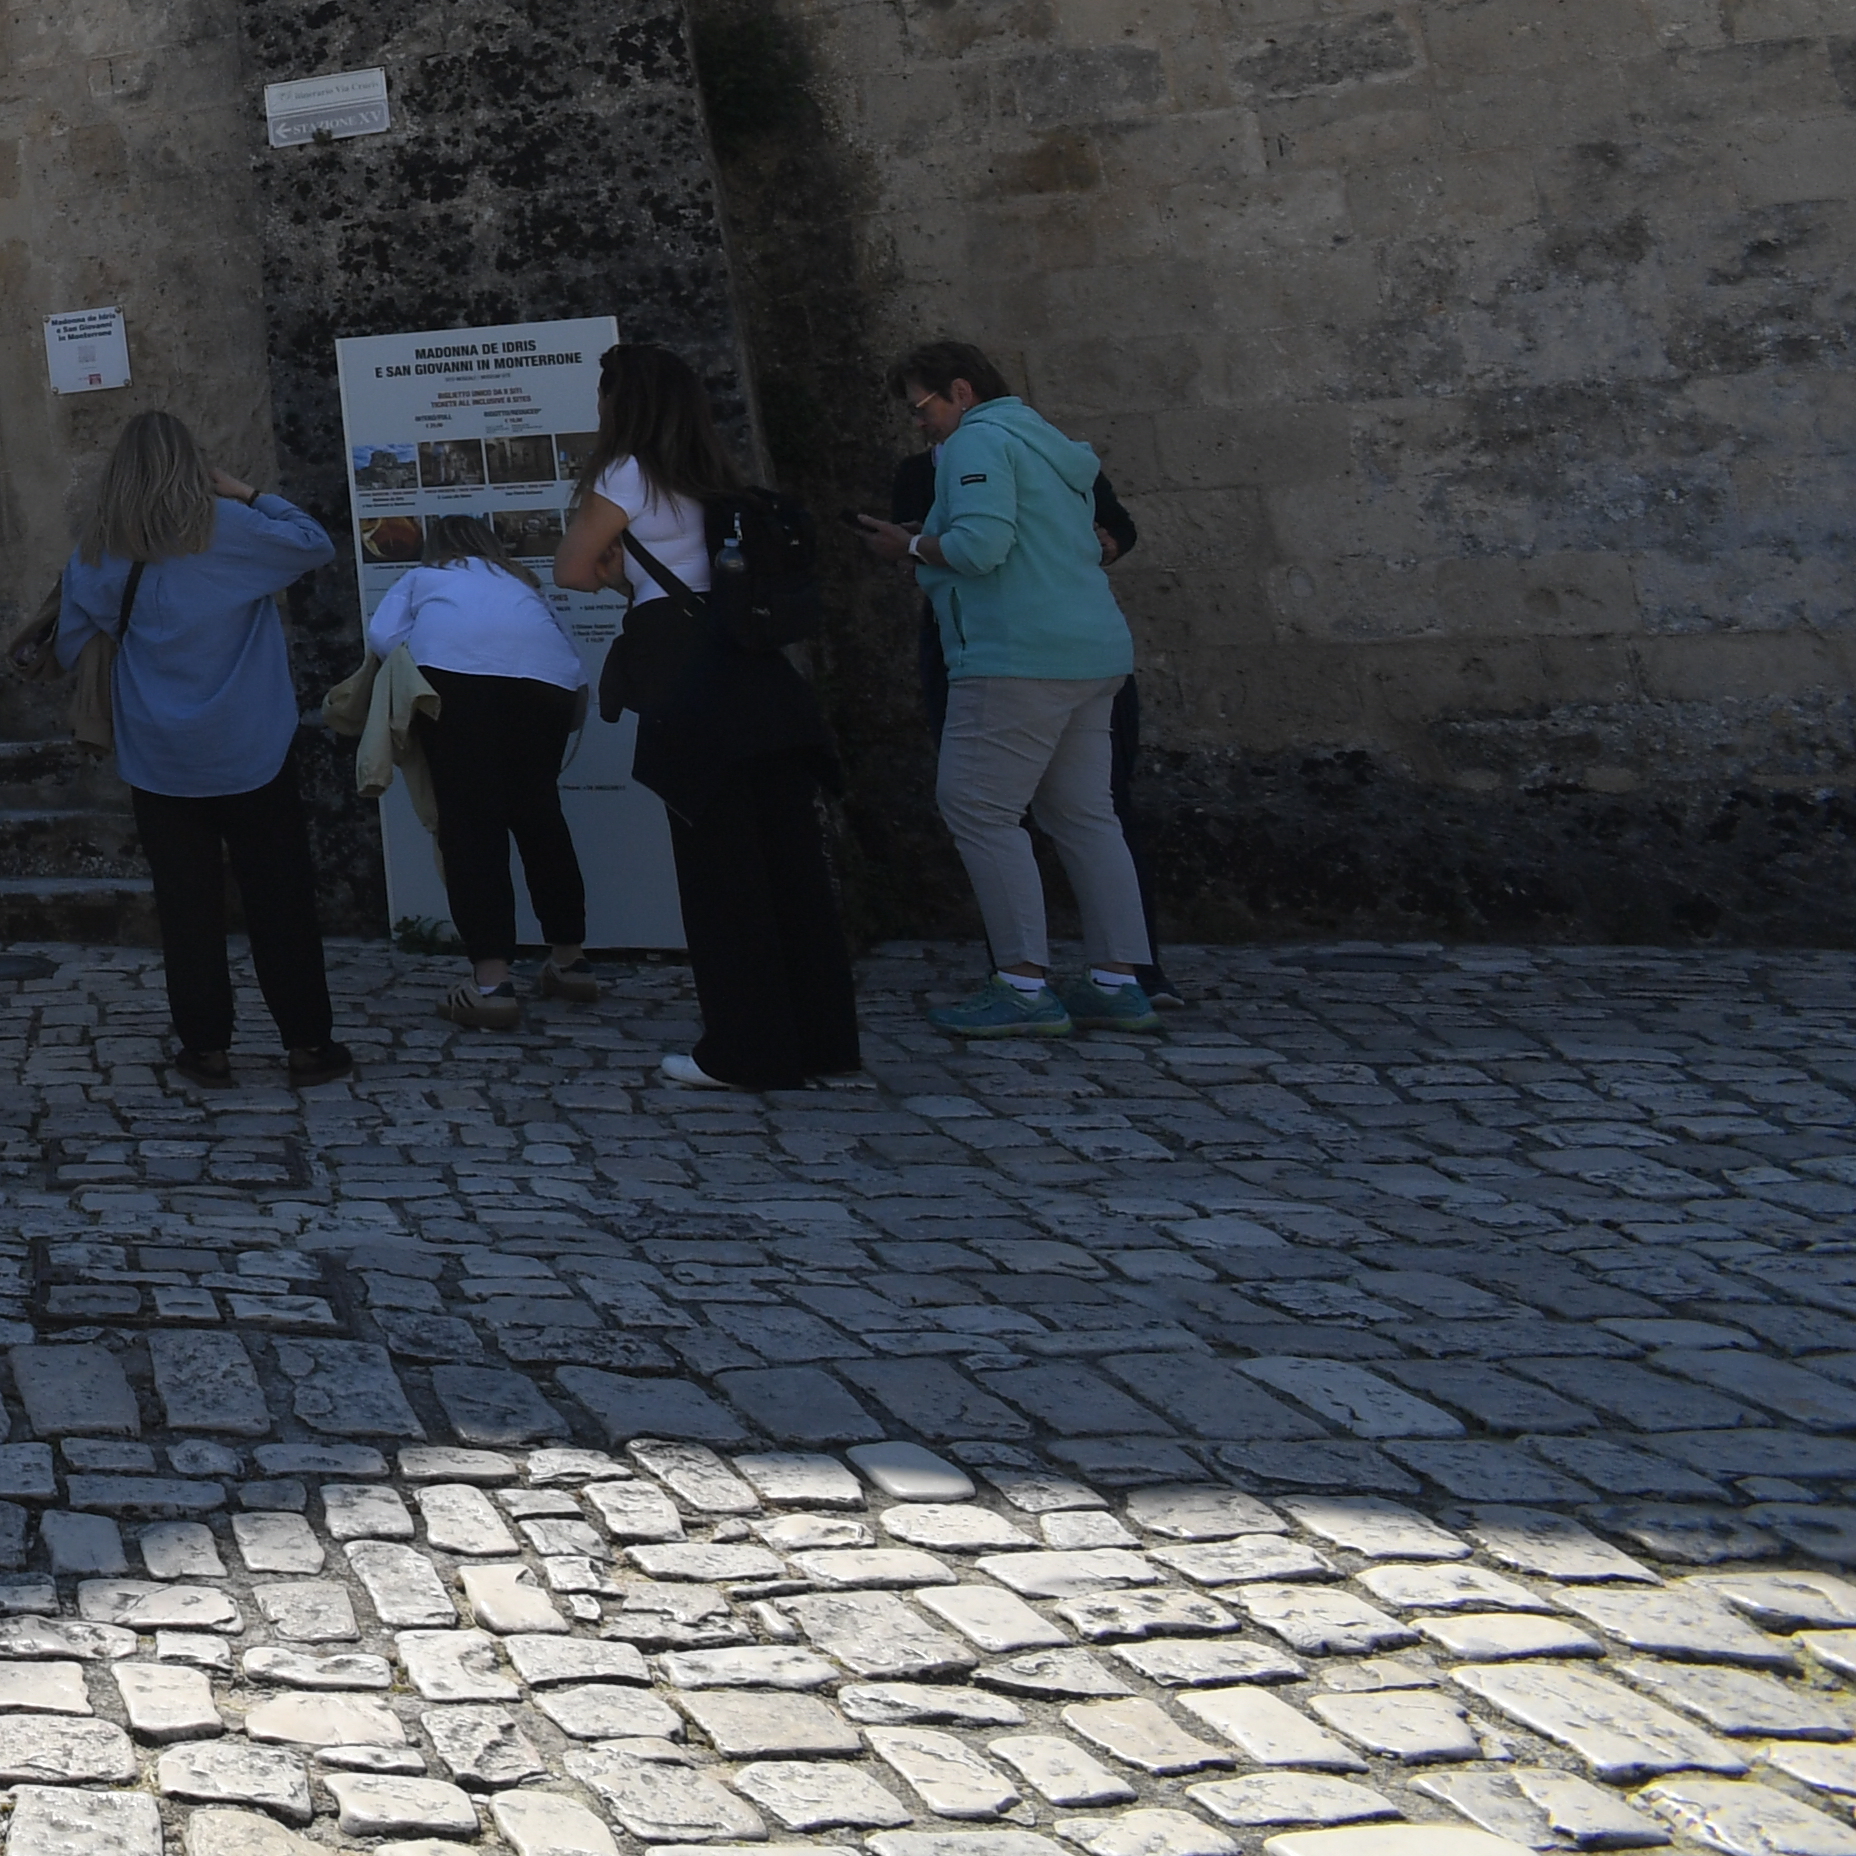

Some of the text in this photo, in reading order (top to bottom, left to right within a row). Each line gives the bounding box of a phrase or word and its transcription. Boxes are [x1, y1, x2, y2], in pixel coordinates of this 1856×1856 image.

[358, 111, 381, 125] XV
[51, 316, 86, 326] Madonna
[98, 312, 116, 320] Idris
[79, 321, 112, 331] Giovanni
[68, 330, 112, 340] Monterrone
[415, 340, 536, 360] MADONNA DE IDRIS
[375, 352, 583, 378] E SAN GIOVANNI IN MONTERRONE
